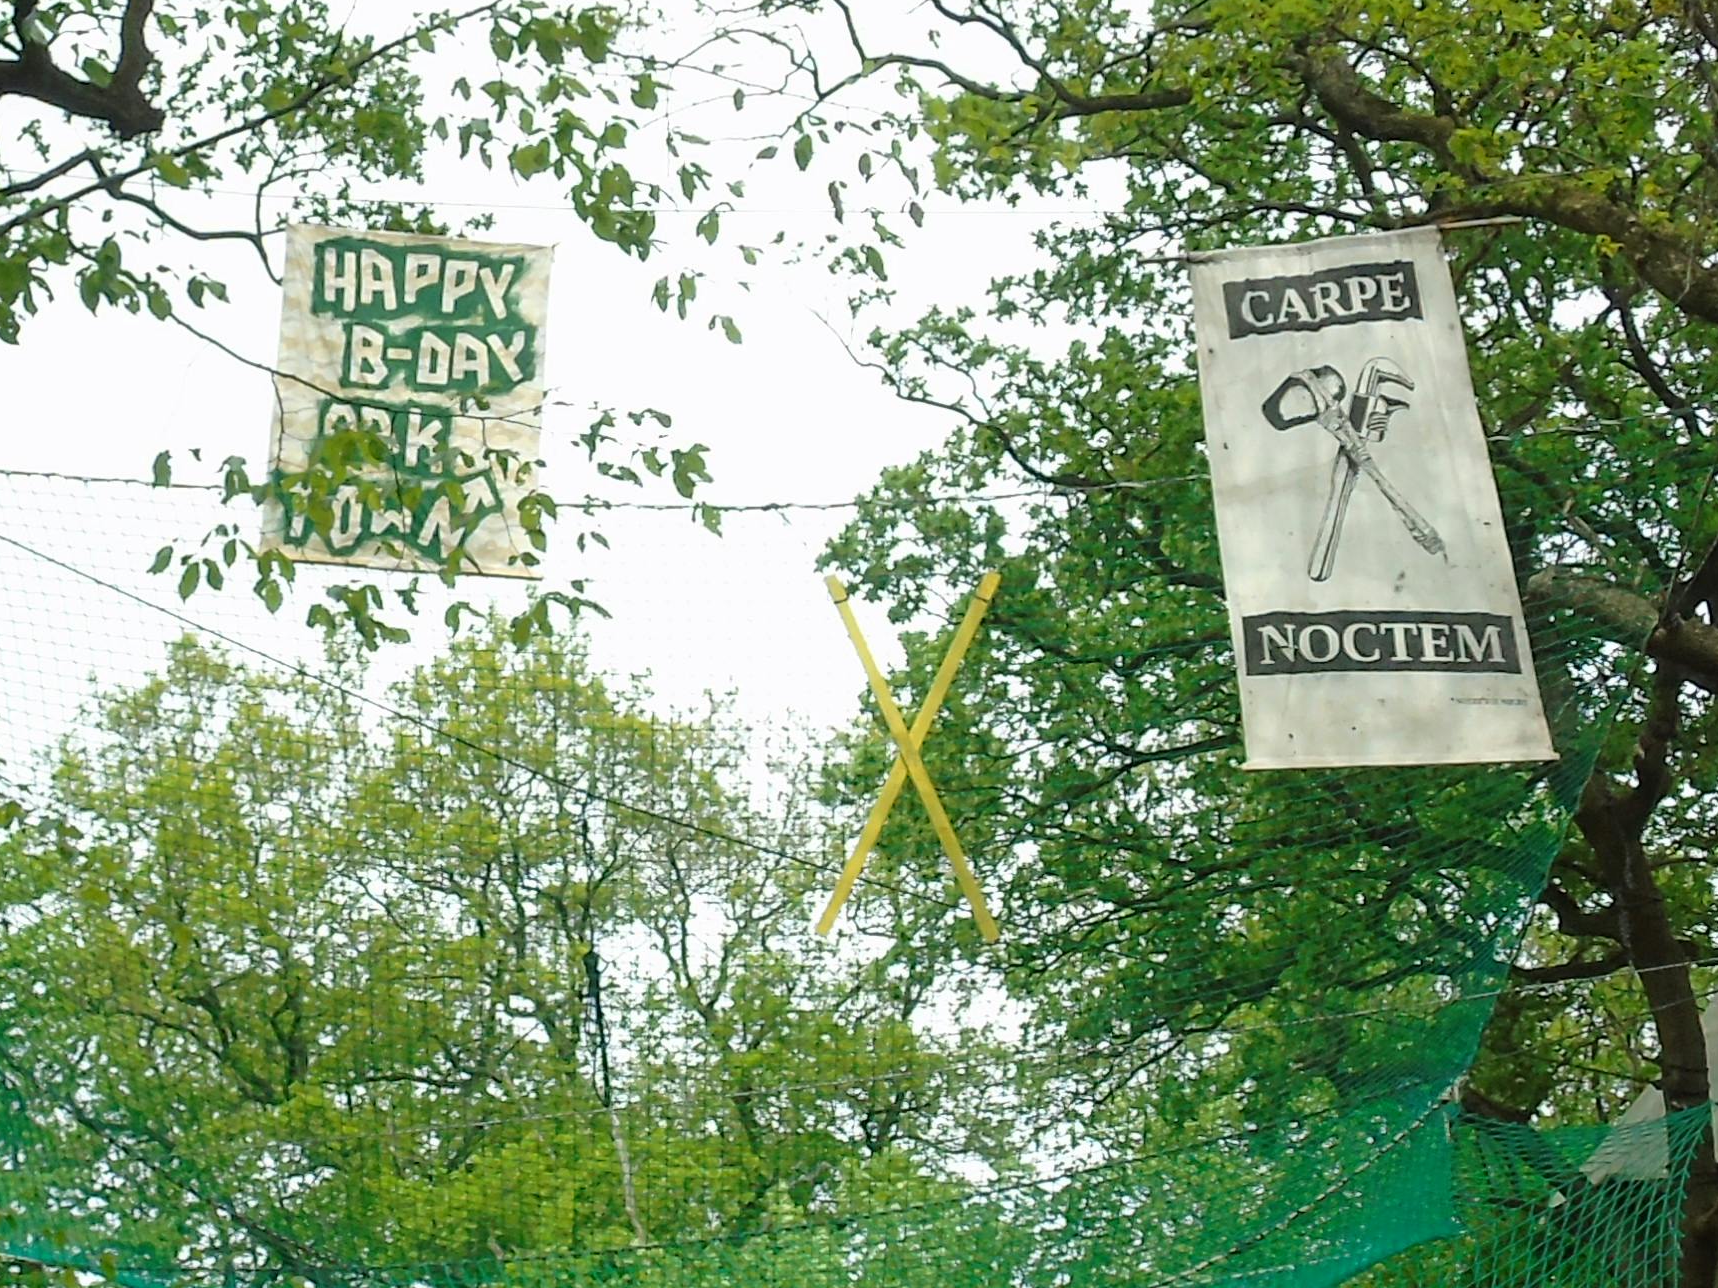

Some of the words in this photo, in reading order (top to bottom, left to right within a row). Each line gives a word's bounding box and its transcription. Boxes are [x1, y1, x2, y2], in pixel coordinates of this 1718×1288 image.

[324, 248, 515, 319] HAPPY
[1241, 272, 1411, 328] CARPE
[350, 326, 525, 386] B-DAY
[1257, 622, 1507, 665] NOCTEM
